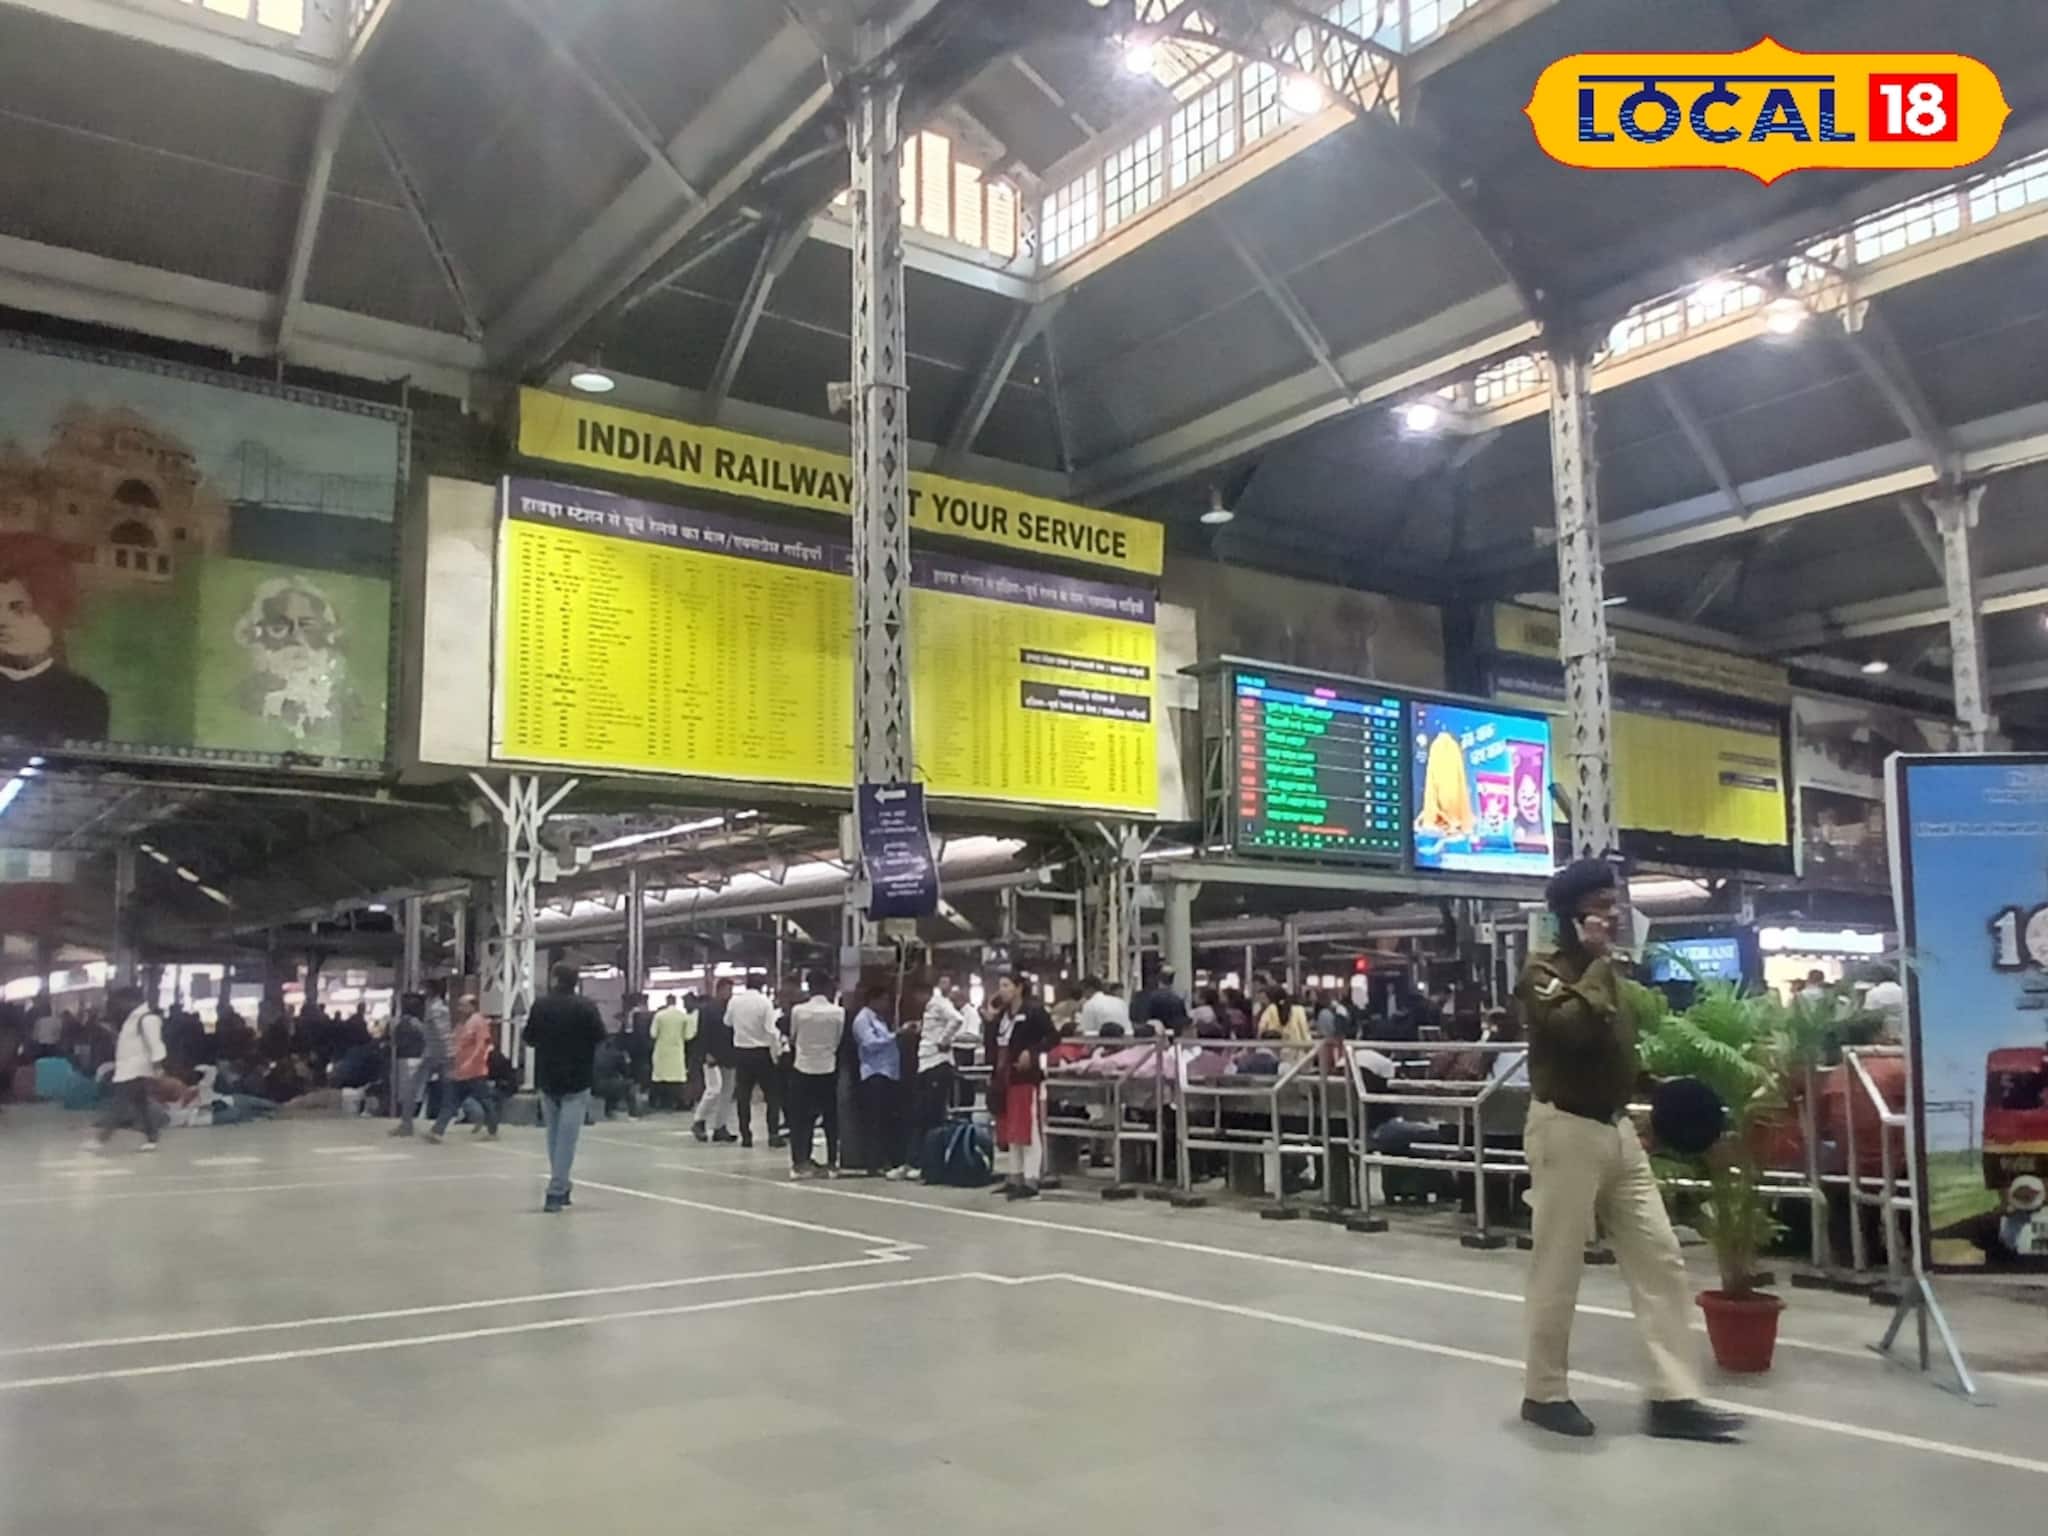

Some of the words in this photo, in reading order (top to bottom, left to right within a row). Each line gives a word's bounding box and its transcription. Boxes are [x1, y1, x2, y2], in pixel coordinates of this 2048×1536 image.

[578, 419, 702, 474] INDIAN
[907, 488, 923, 517] T
[932, 493, 1008, 536] YOUR
[1018, 511, 1127, 559] SERVICE
